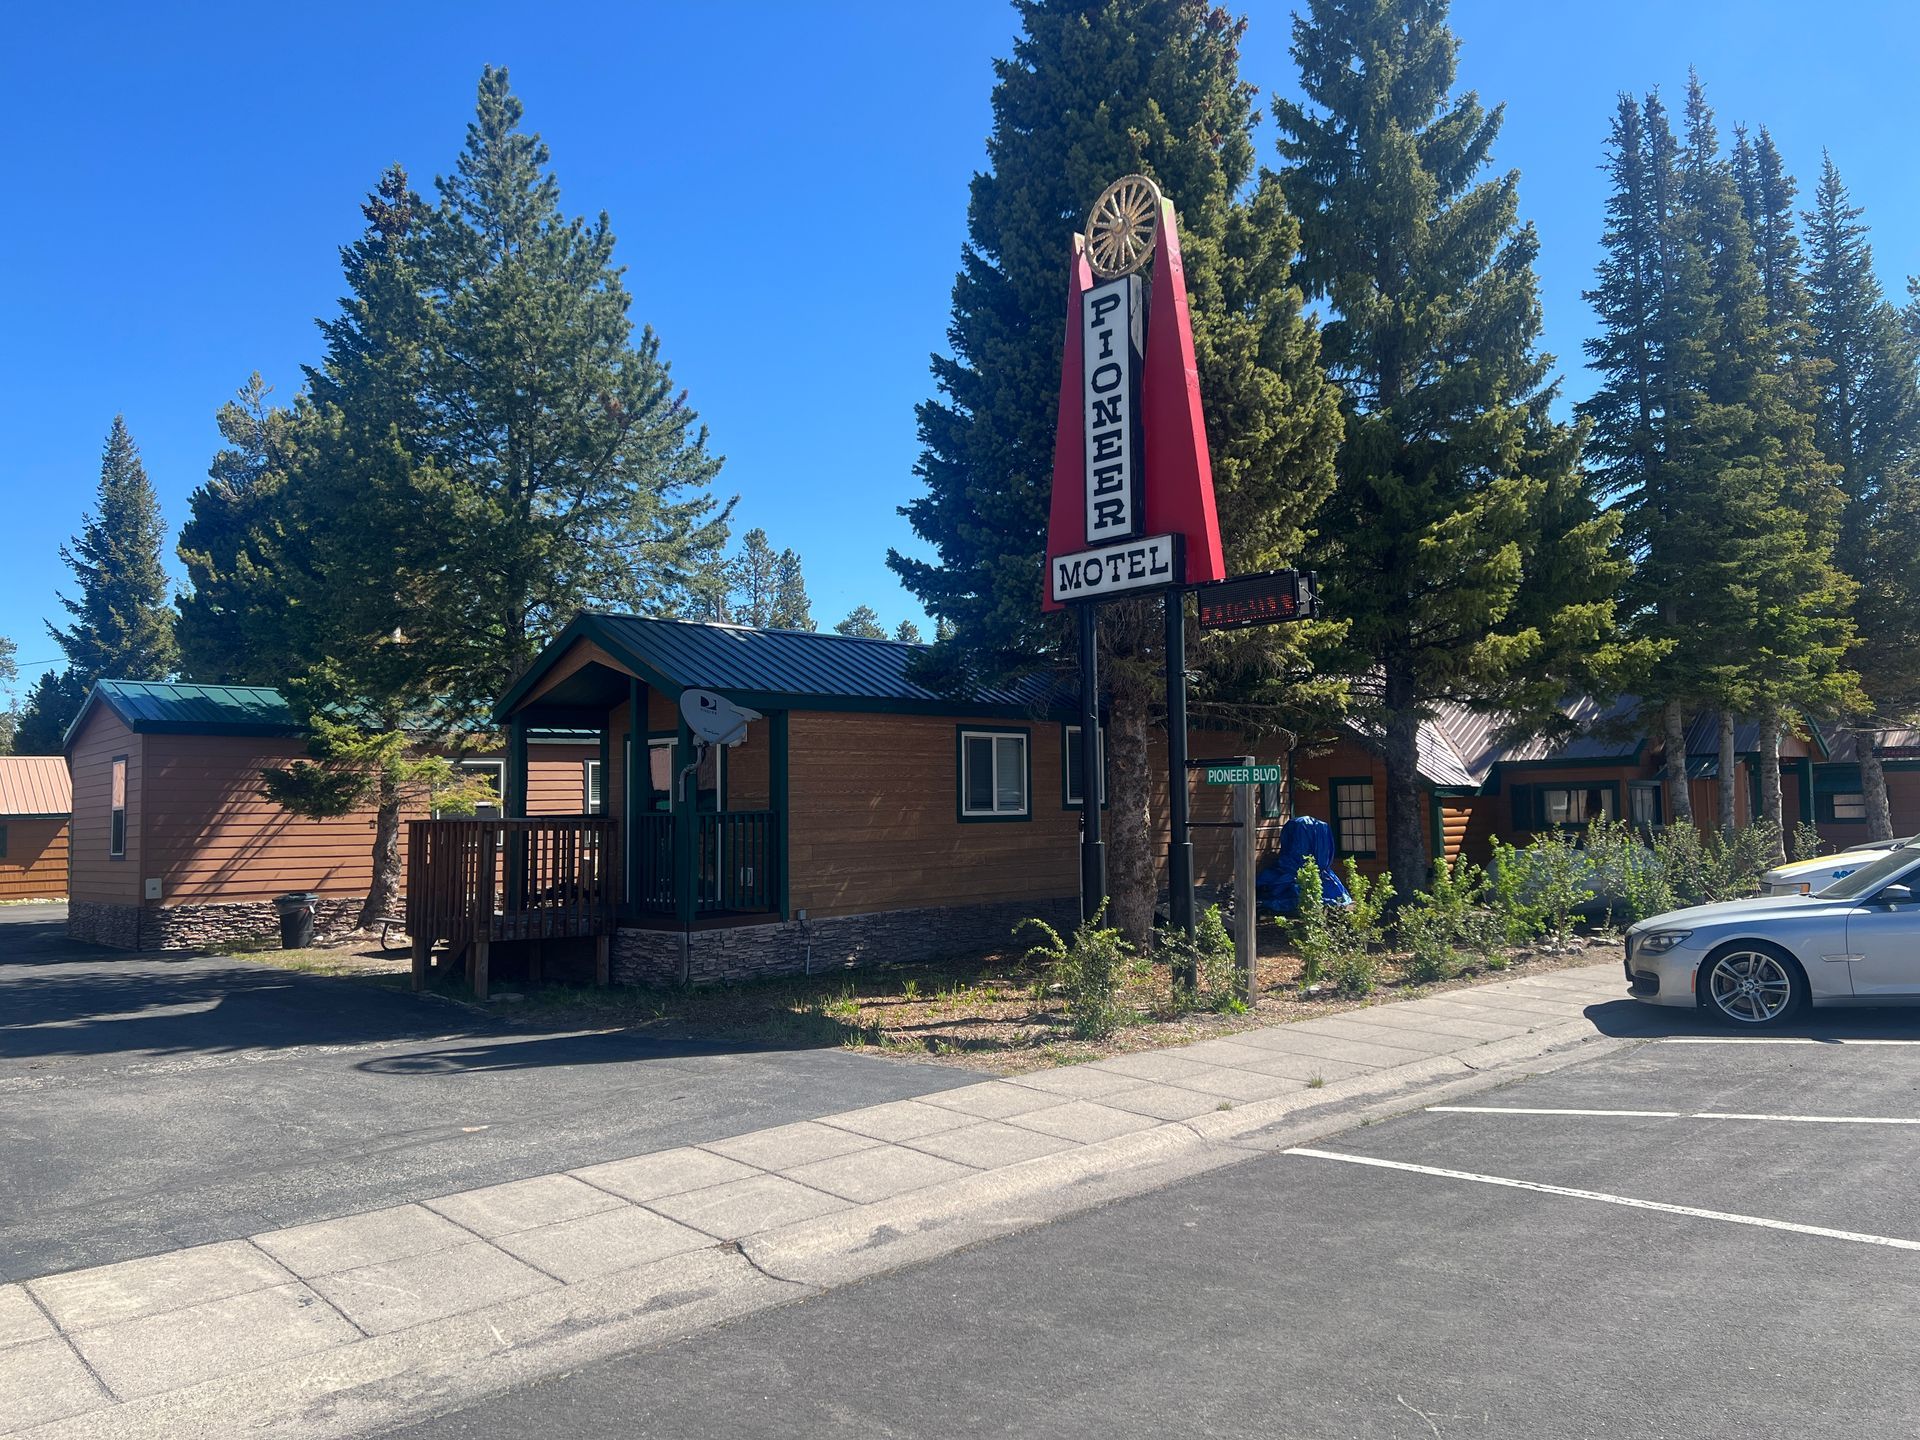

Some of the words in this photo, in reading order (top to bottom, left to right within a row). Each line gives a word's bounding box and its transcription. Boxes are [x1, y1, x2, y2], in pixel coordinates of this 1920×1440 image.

[1091, 293, 1125, 529] PIONEER
[1059, 546, 1168, 591] MOTEL
[1208, 769, 1249, 782] PIONEER
[1253, 768, 1278, 781] BLVD
